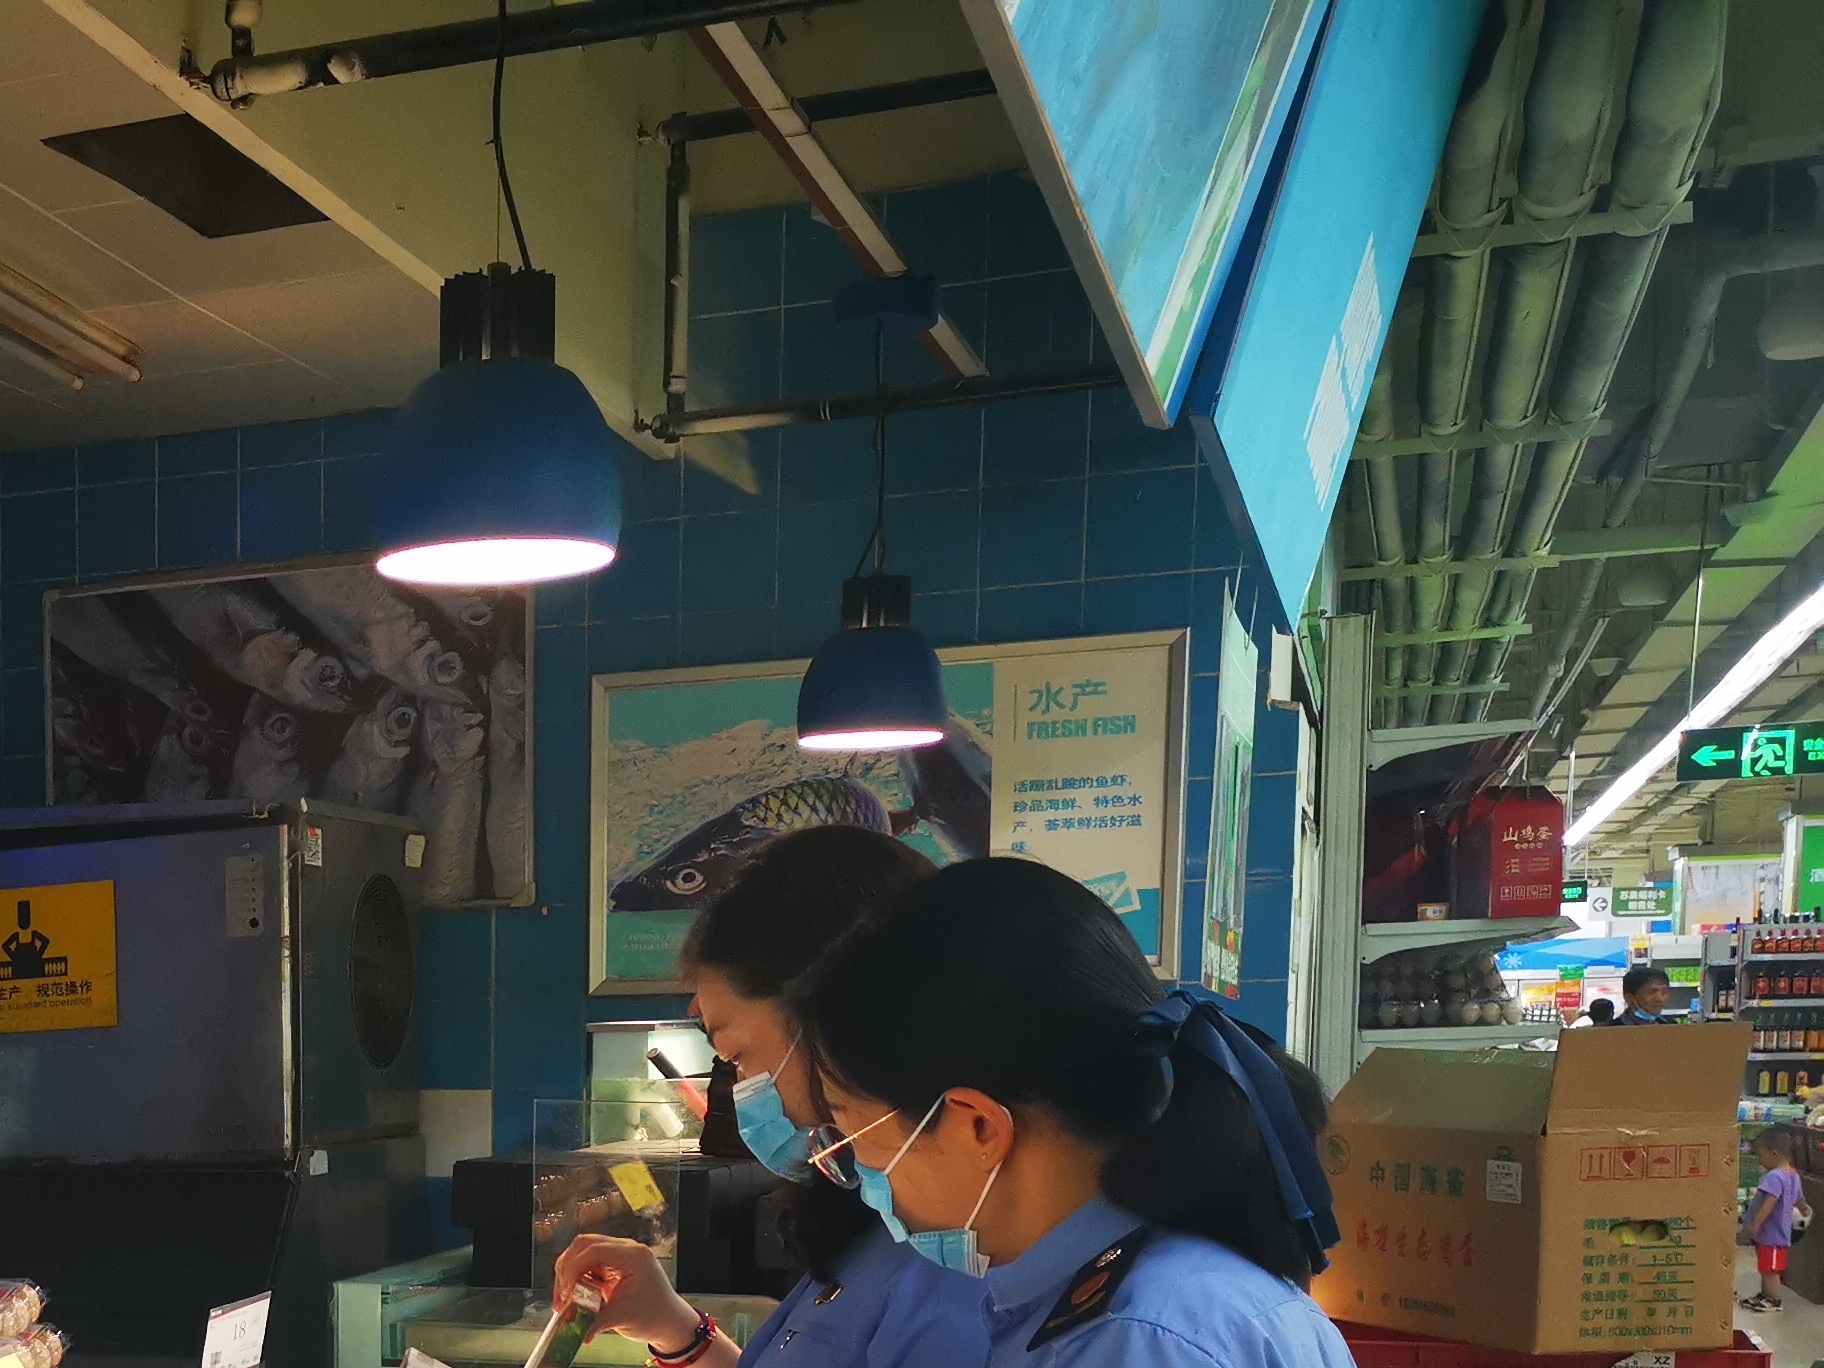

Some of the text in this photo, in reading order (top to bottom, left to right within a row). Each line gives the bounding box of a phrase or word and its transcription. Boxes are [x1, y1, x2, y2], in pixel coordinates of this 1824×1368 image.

[1028, 678, 1108, 715] 水产
[1027, 714, 1136, 740] FRESH FISH
[1502, 825, 1553, 842] 山鸡蛋
[49, 997, 92, 1008] operation
